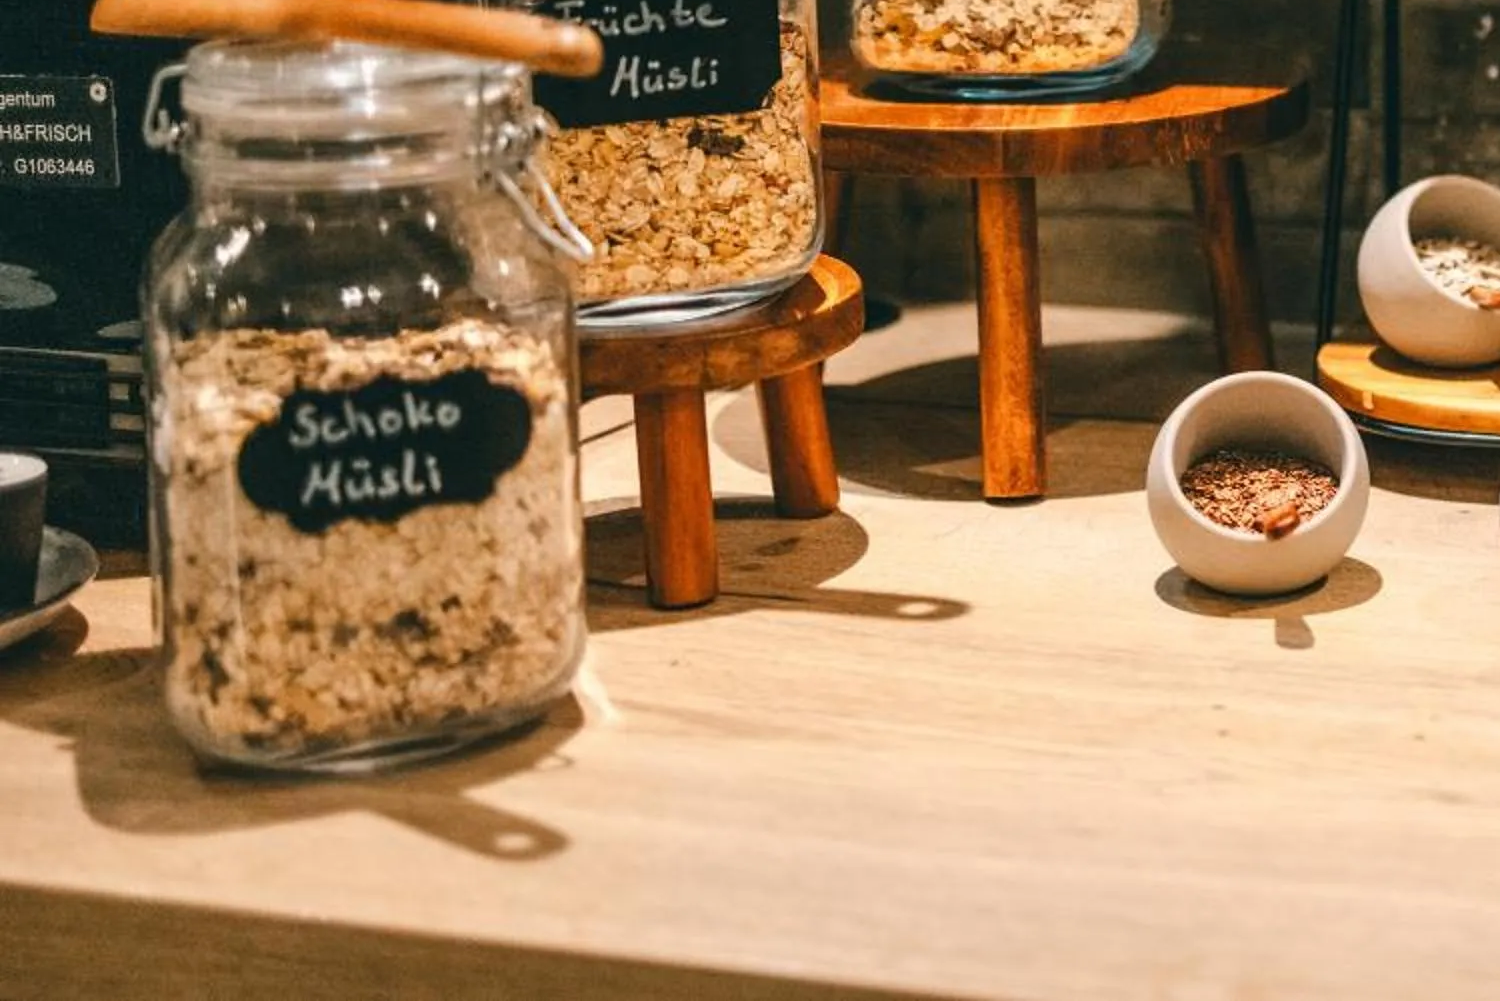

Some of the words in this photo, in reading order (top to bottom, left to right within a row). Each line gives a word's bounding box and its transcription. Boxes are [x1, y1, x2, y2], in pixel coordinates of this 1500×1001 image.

[609, 54, 720, 99] Müsli
[0, 123, 92, 143] H&FRISCH
[14, 158, 95, 175] G1063446
[288, 390, 462, 448] Schoko
[301, 448, 443, 506] Müsli
